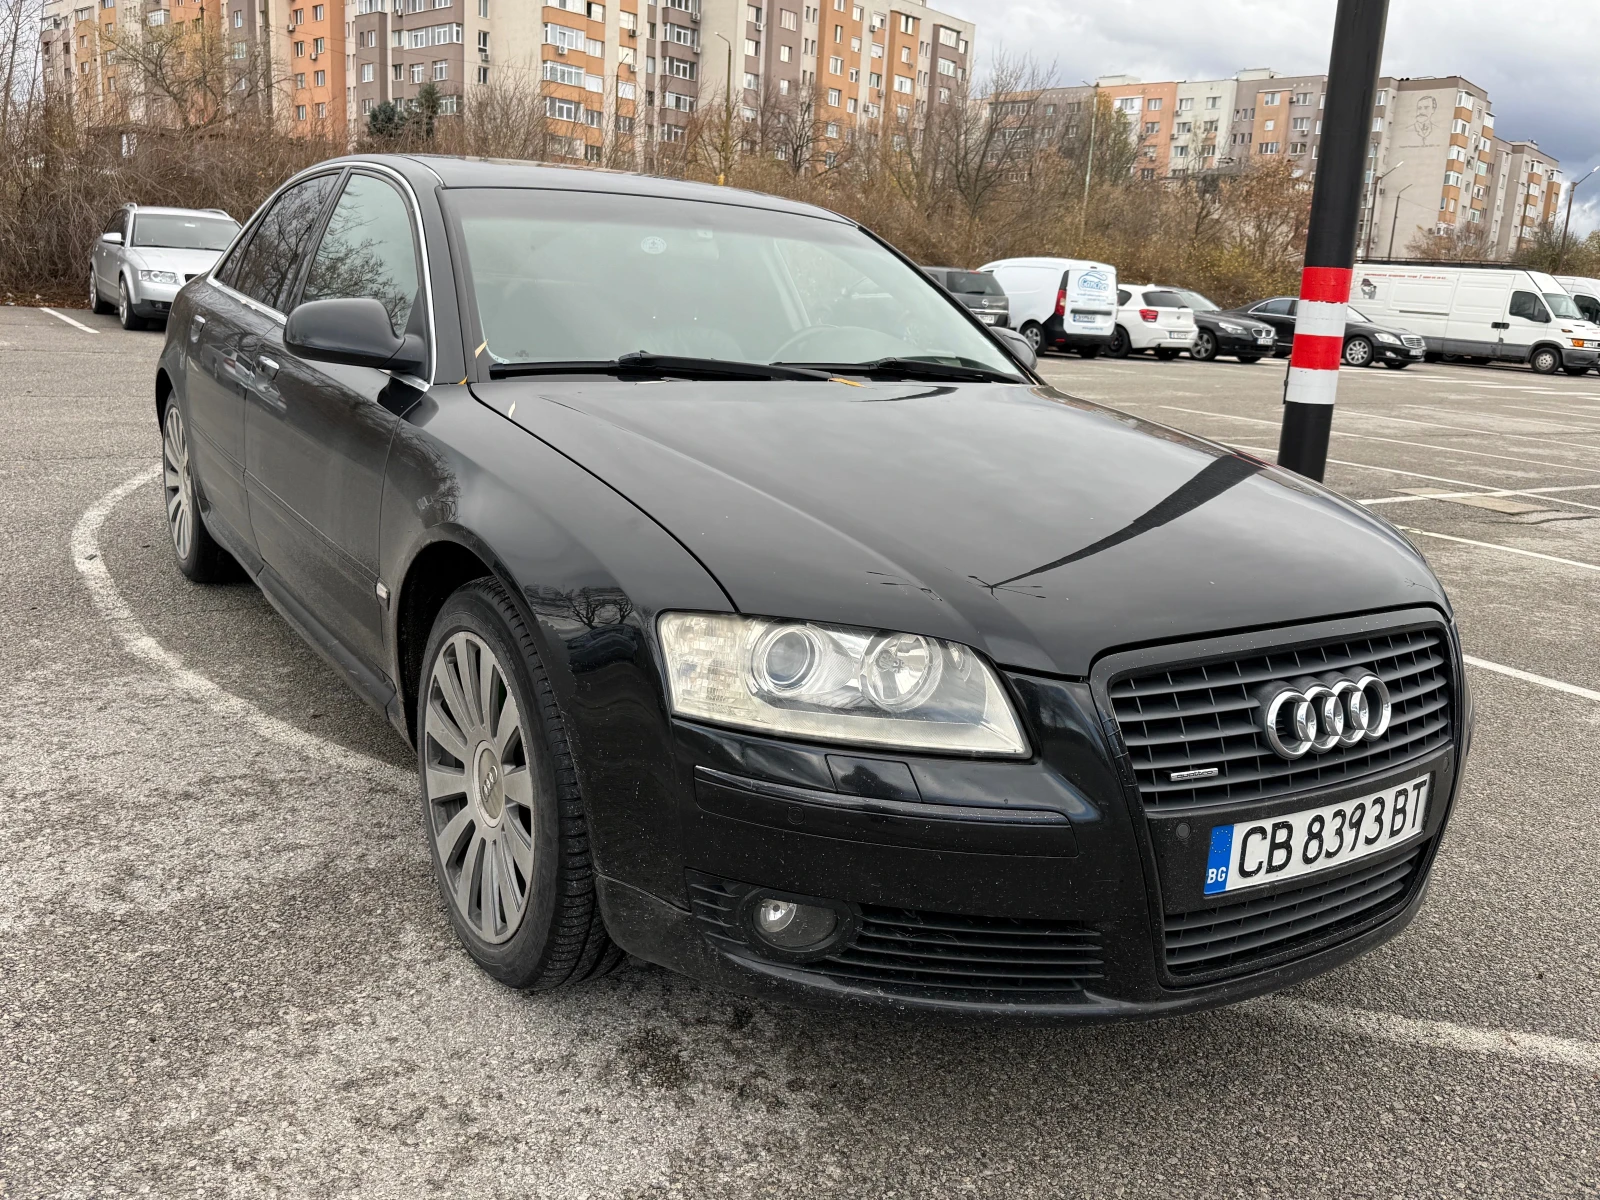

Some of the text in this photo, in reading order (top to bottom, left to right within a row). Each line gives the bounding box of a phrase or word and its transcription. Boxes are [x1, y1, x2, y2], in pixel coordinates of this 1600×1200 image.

[1238, 779, 1427, 879] CB 8393 BT
[1206, 866, 1227, 885] BG
